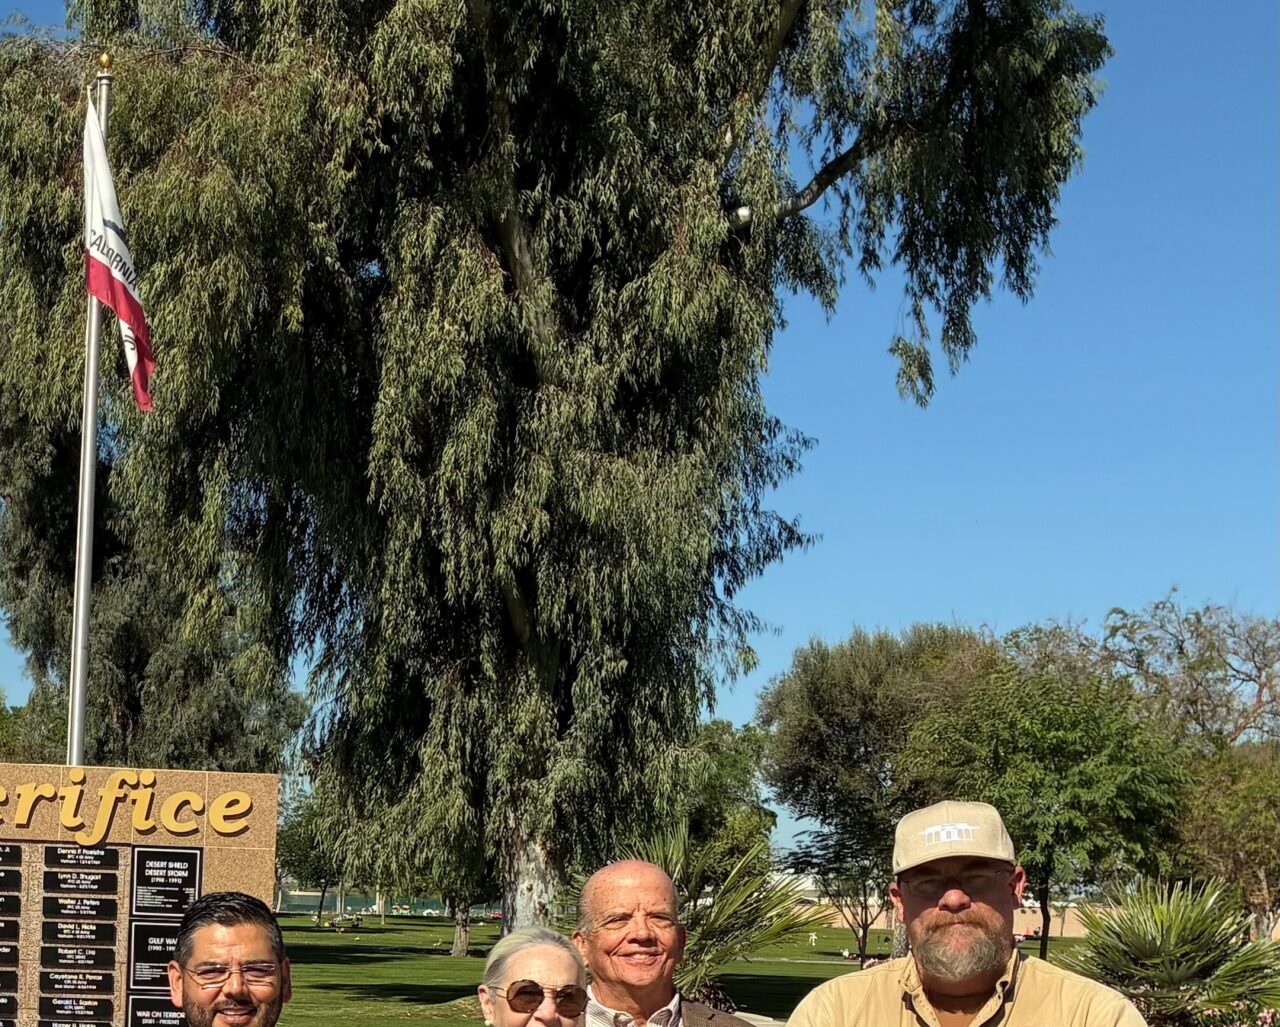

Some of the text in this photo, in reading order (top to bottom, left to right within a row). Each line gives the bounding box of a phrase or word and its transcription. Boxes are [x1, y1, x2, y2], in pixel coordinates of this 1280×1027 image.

[168, 861, 188, 869] SHIELD
[148, 937, 164, 945] GULF
[136, 1010, 150, 1018] WAR
[163, 1011, 186, 1019] TERROR
